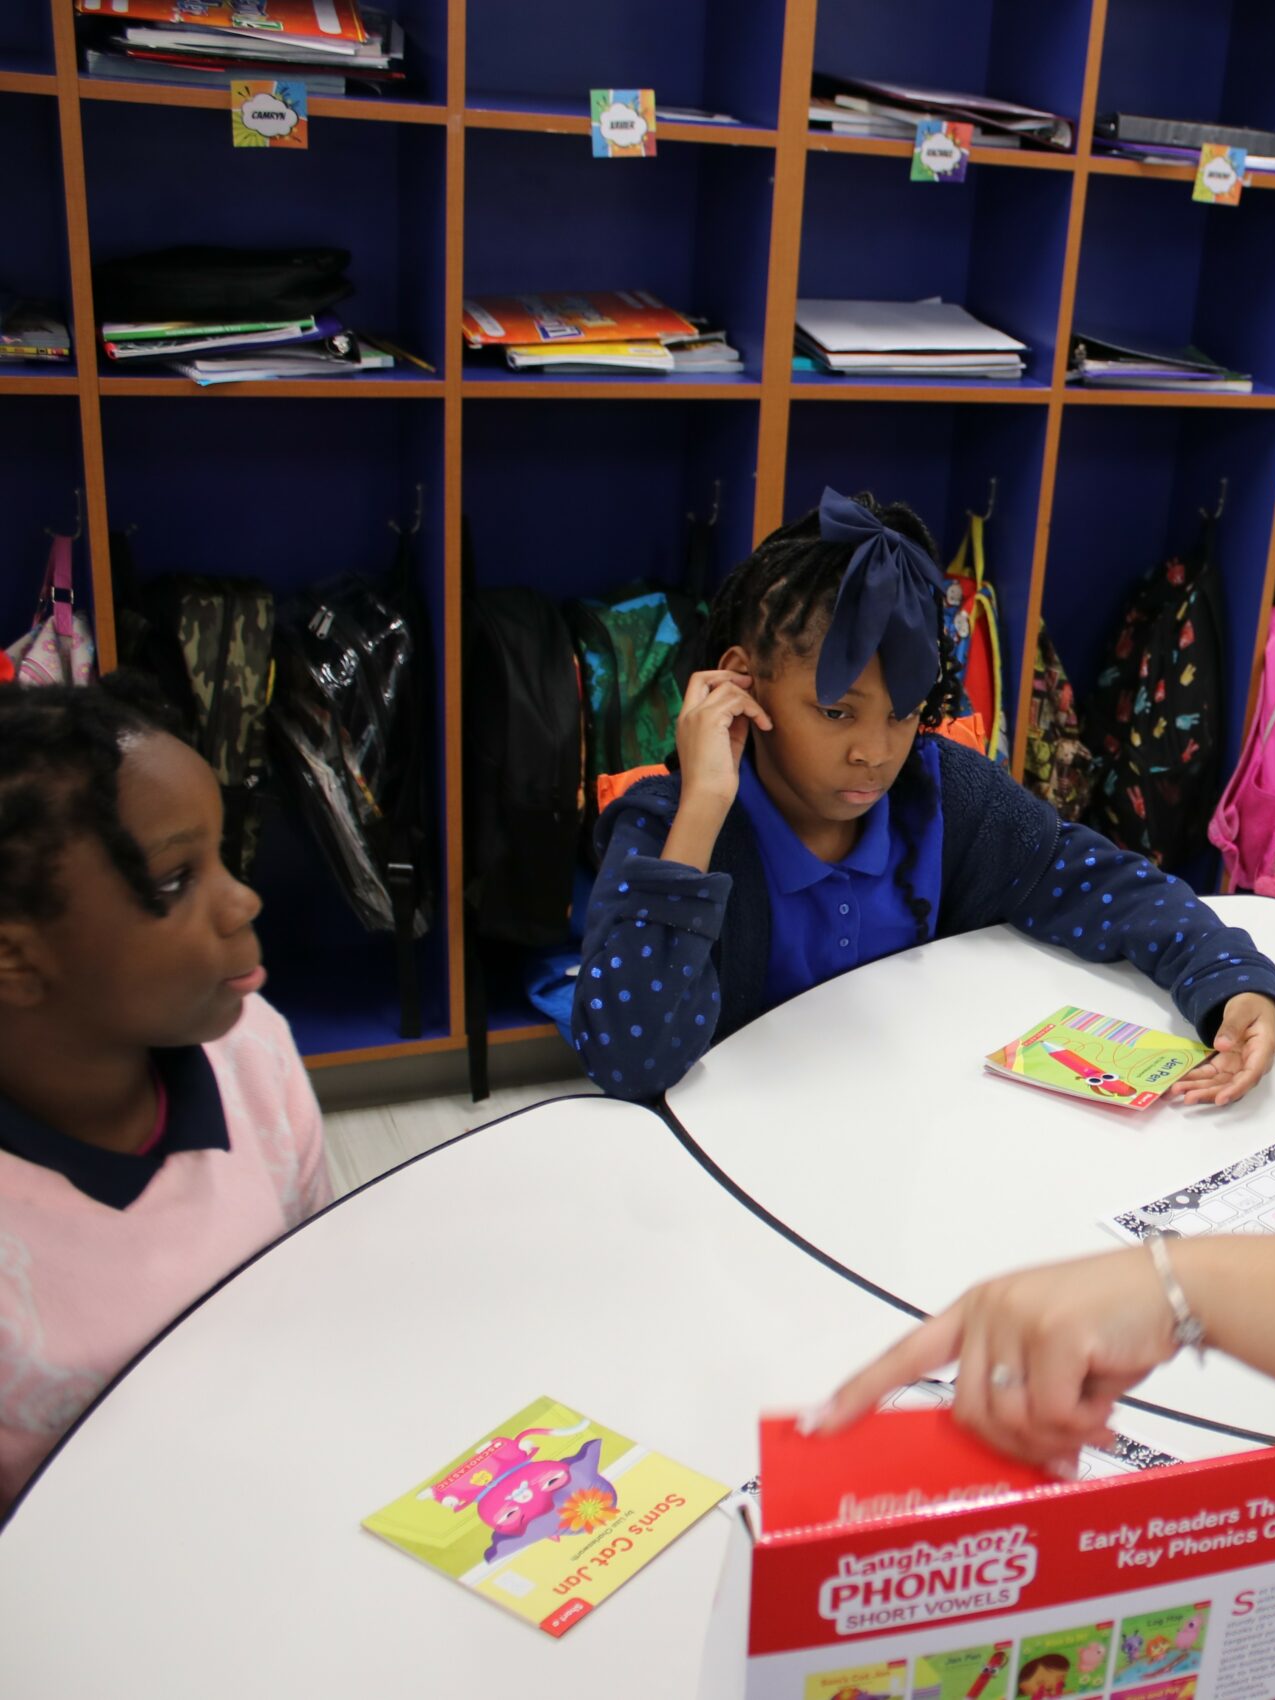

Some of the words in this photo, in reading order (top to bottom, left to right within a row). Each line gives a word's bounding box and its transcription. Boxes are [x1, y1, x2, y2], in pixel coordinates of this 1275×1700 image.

[437, 1447, 496, 1489] SCHOLASTIC
[628, 1494, 687, 1535] Sam's
[1079, 1525, 1142, 1552] Early
[1148, 1506, 1240, 1540] Readers
[590, 1537, 634, 1567] Cat
[843, 1531, 1021, 1577] Laugh-a-Lot!
[1118, 1543, 1162, 1569] Key
[1168, 1525, 1258, 1559] Phonics
[552, 1566, 593, 1595] Jan
[829, 1554, 1028, 1613] PHONICS
[846, 1605, 920, 1629] SHORT
[924, 1589, 1010, 1616] VOWELS
